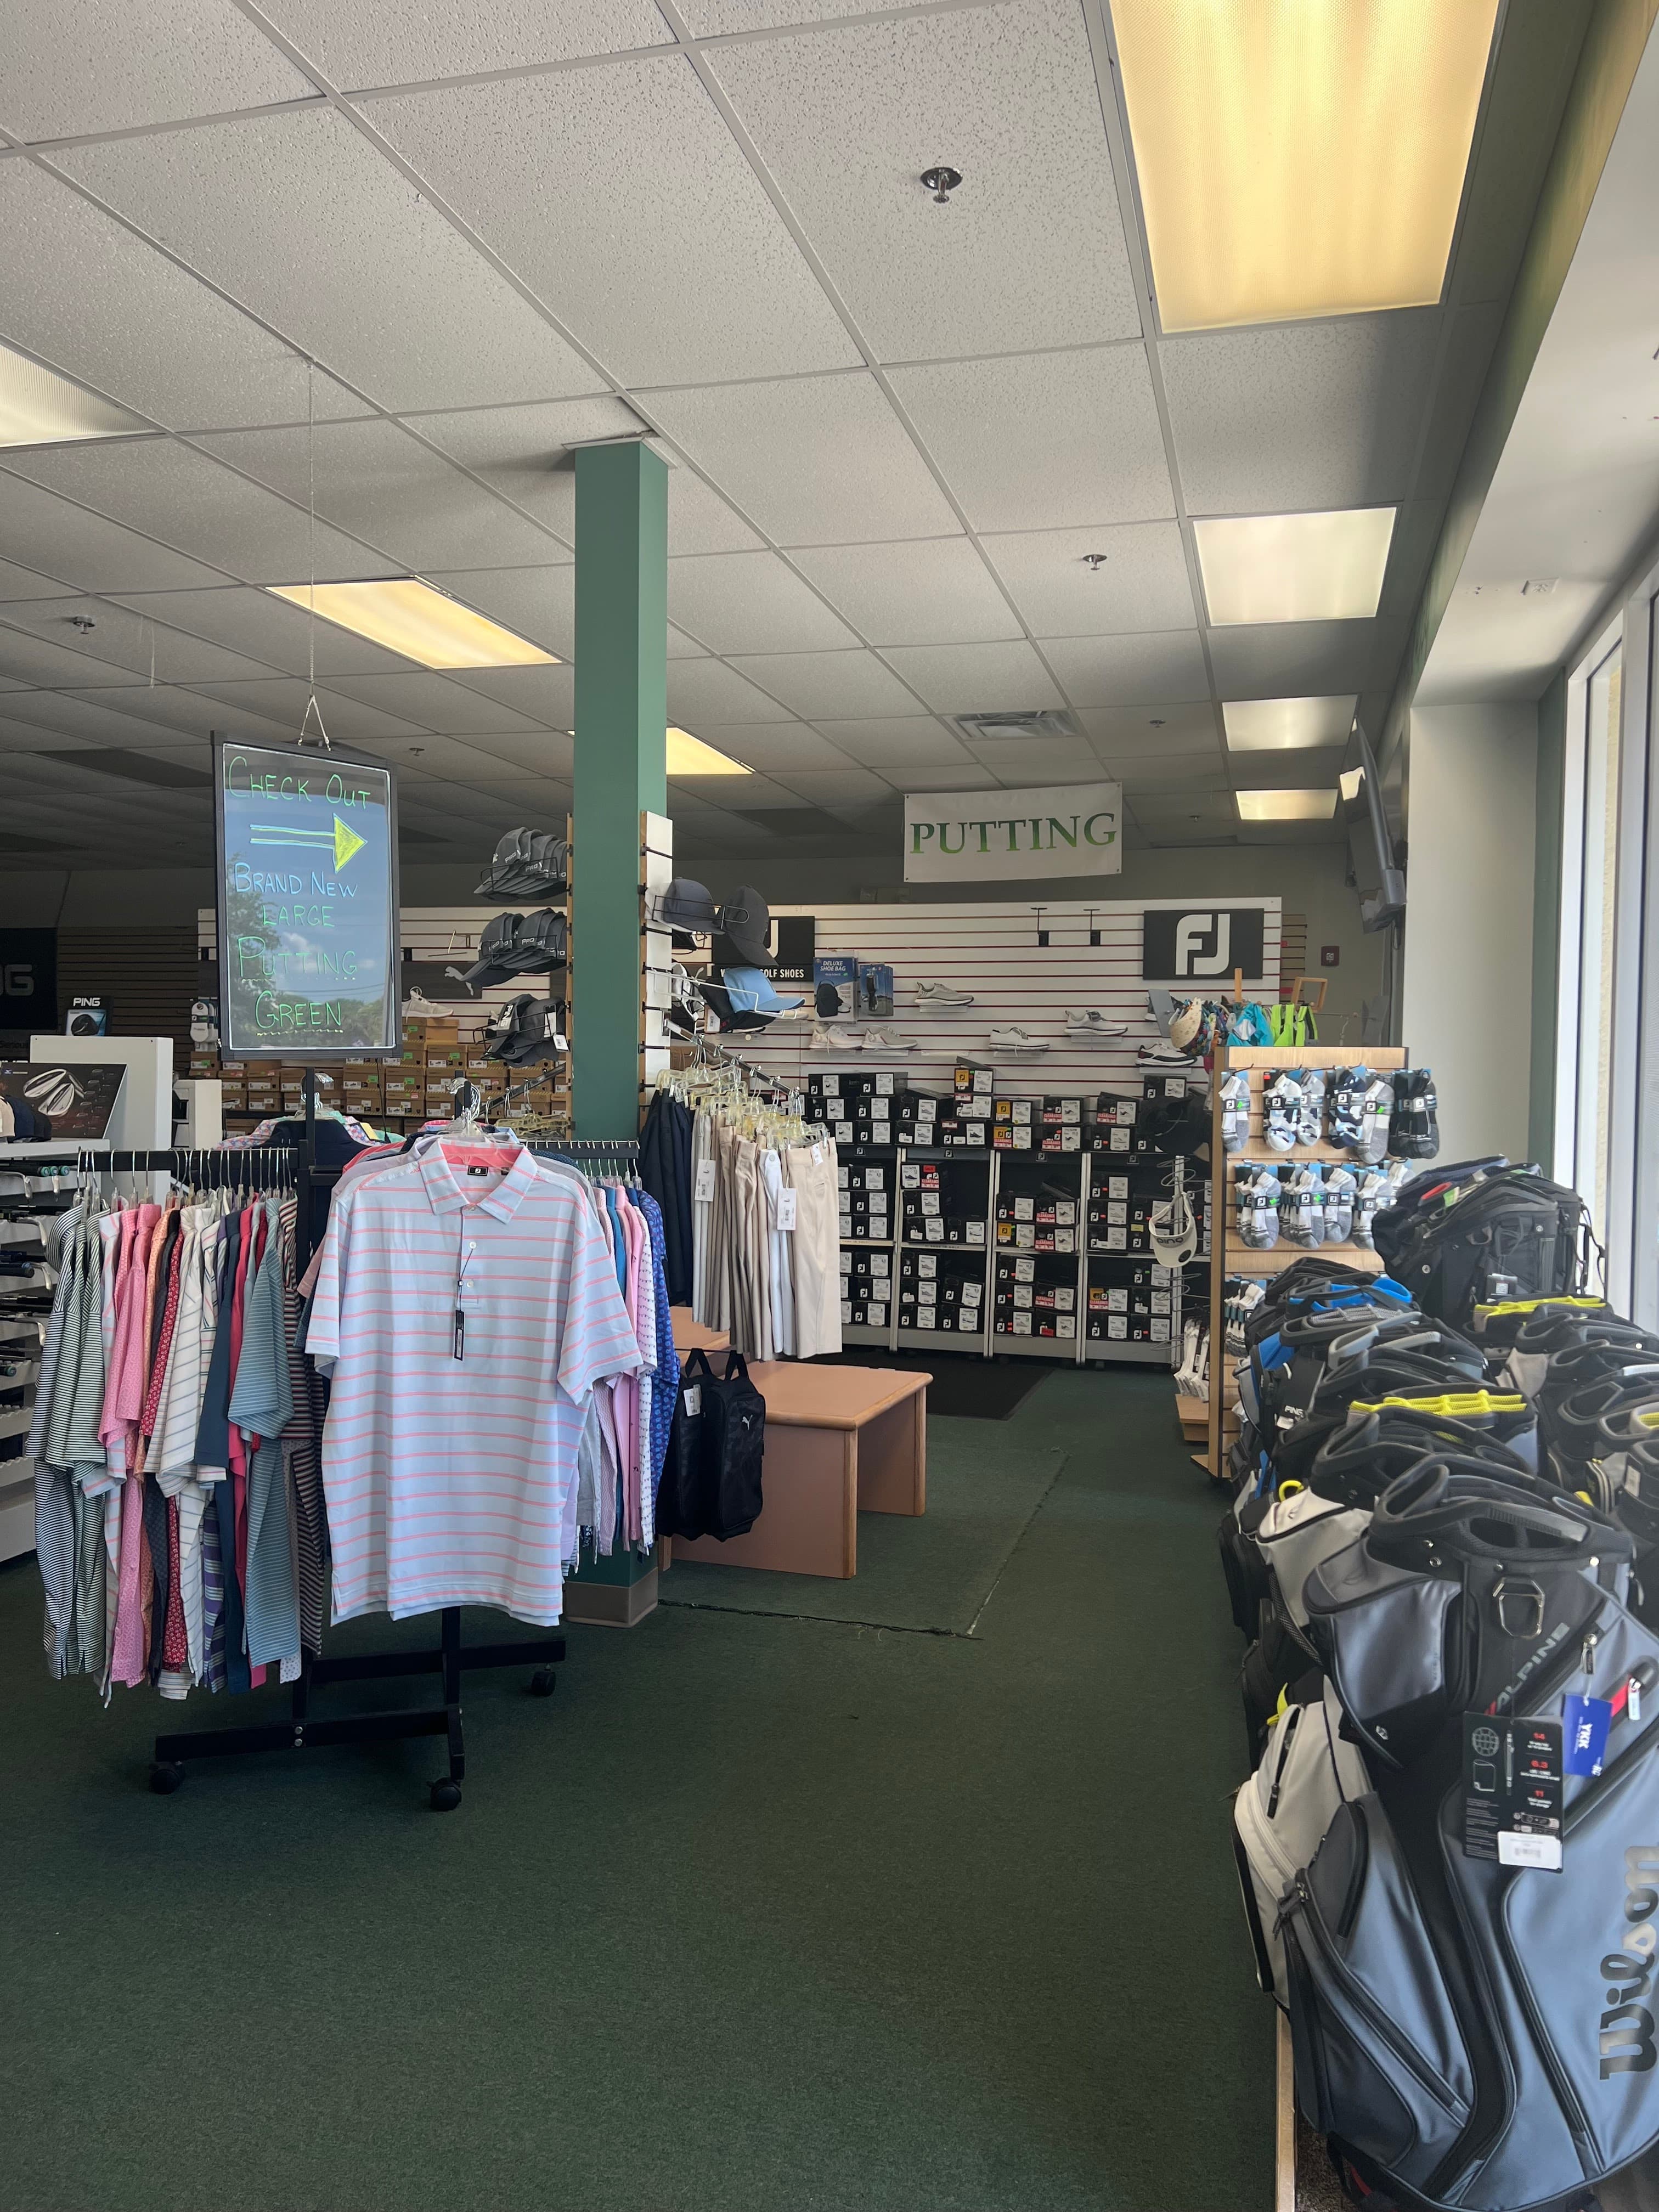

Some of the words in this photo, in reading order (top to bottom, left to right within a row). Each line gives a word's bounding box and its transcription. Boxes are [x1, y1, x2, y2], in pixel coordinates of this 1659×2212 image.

[228, 755, 312, 803] CHECK
[326, 774, 371, 810] OUT
[910, 812, 1117, 854] PUTTING
[505, 851, 516, 864] PRO
[526, 864, 538, 872] PRO
[235, 861, 302, 893] BRAND
[311, 871, 358, 898] NEW
[262, 905, 335, 927] LARGE
[766, 919, 779, 958] J
[1175, 913, 1231, 975] FJ
[238, 936, 357, 977] PUTTING
[760, 969, 777, 978] OLF
[780, 969, 804, 978] SHOES
[73, 997, 101, 1006] PING
[255, 990, 342, 1030] GREEN
[500, 1005, 514, 1027] PING
[811, 1085, 818, 1094] FJ
[863, 1084, 871, 1093] FJ
[1147, 1089, 1156, 1098] FJ
[1338, 1093, 1347, 1103] FJ
[1226, 1101, 1234, 1109] FJ
[1272, 1098, 1281, 1107] FJ
[1367, 1102, 1376, 1111] FJ
[815, 1108, 822, 1118] FJ
[859, 1108, 866, 1116] FJ
[902, 1108, 910, 1118] FJ
[860, 1132, 868, 1141] FJ
[944, 1135, 951, 1144] FJ
[1093, 1139, 1102, 1149] FJ
[1138, 1141, 1146, 1150] FJ
[853, 1178, 860, 1187] FJ
[1092, 1188, 1101, 1198] FJ
[1257, 1197, 1266, 1206] FJ
[1301, 1193, 1310, 1203] FJ
[856, 1202, 864, 1211] FJ
[907, 1205, 915, 1214] FJ
[998, 1209, 1007, 1218] FJ
[1091, 1212, 1099, 1222] FJ
[1135, 1211, 1143, 1220] FJ
[856, 1226, 864, 1235] FJ
[950, 1231, 958, 1240] FJ
[1132, 1238, 1141, 1248] FJ
[857, 1263, 865, 1273] FJ
[904, 1266, 911, 1275] FJ
[1000, 1269, 1008, 1278] FJ
[1134, 1274, 1143, 1283] FJ
[860, 1288, 868, 1297] FJ
[946, 1290, 954, 1300] FJ
[997, 1295, 1006, 1304] FJ
[855, 1312, 862, 1321] FJ
[901, 1316, 909, 1325] FJ
[943, 1319, 951, 1328] FJ
[997, 1323, 1005, 1332] FJ
[1092, 1327, 1100, 1336] FJ
[1133, 1330, 1142, 1339] FJ
[1284, 1405, 1304, 1418] PING
[1497, 1622, 1570, 1712] ALPINE
[1578, 1723, 1593, 1749] YKK
[1599, 1846, 1659, 2080] Wilson
